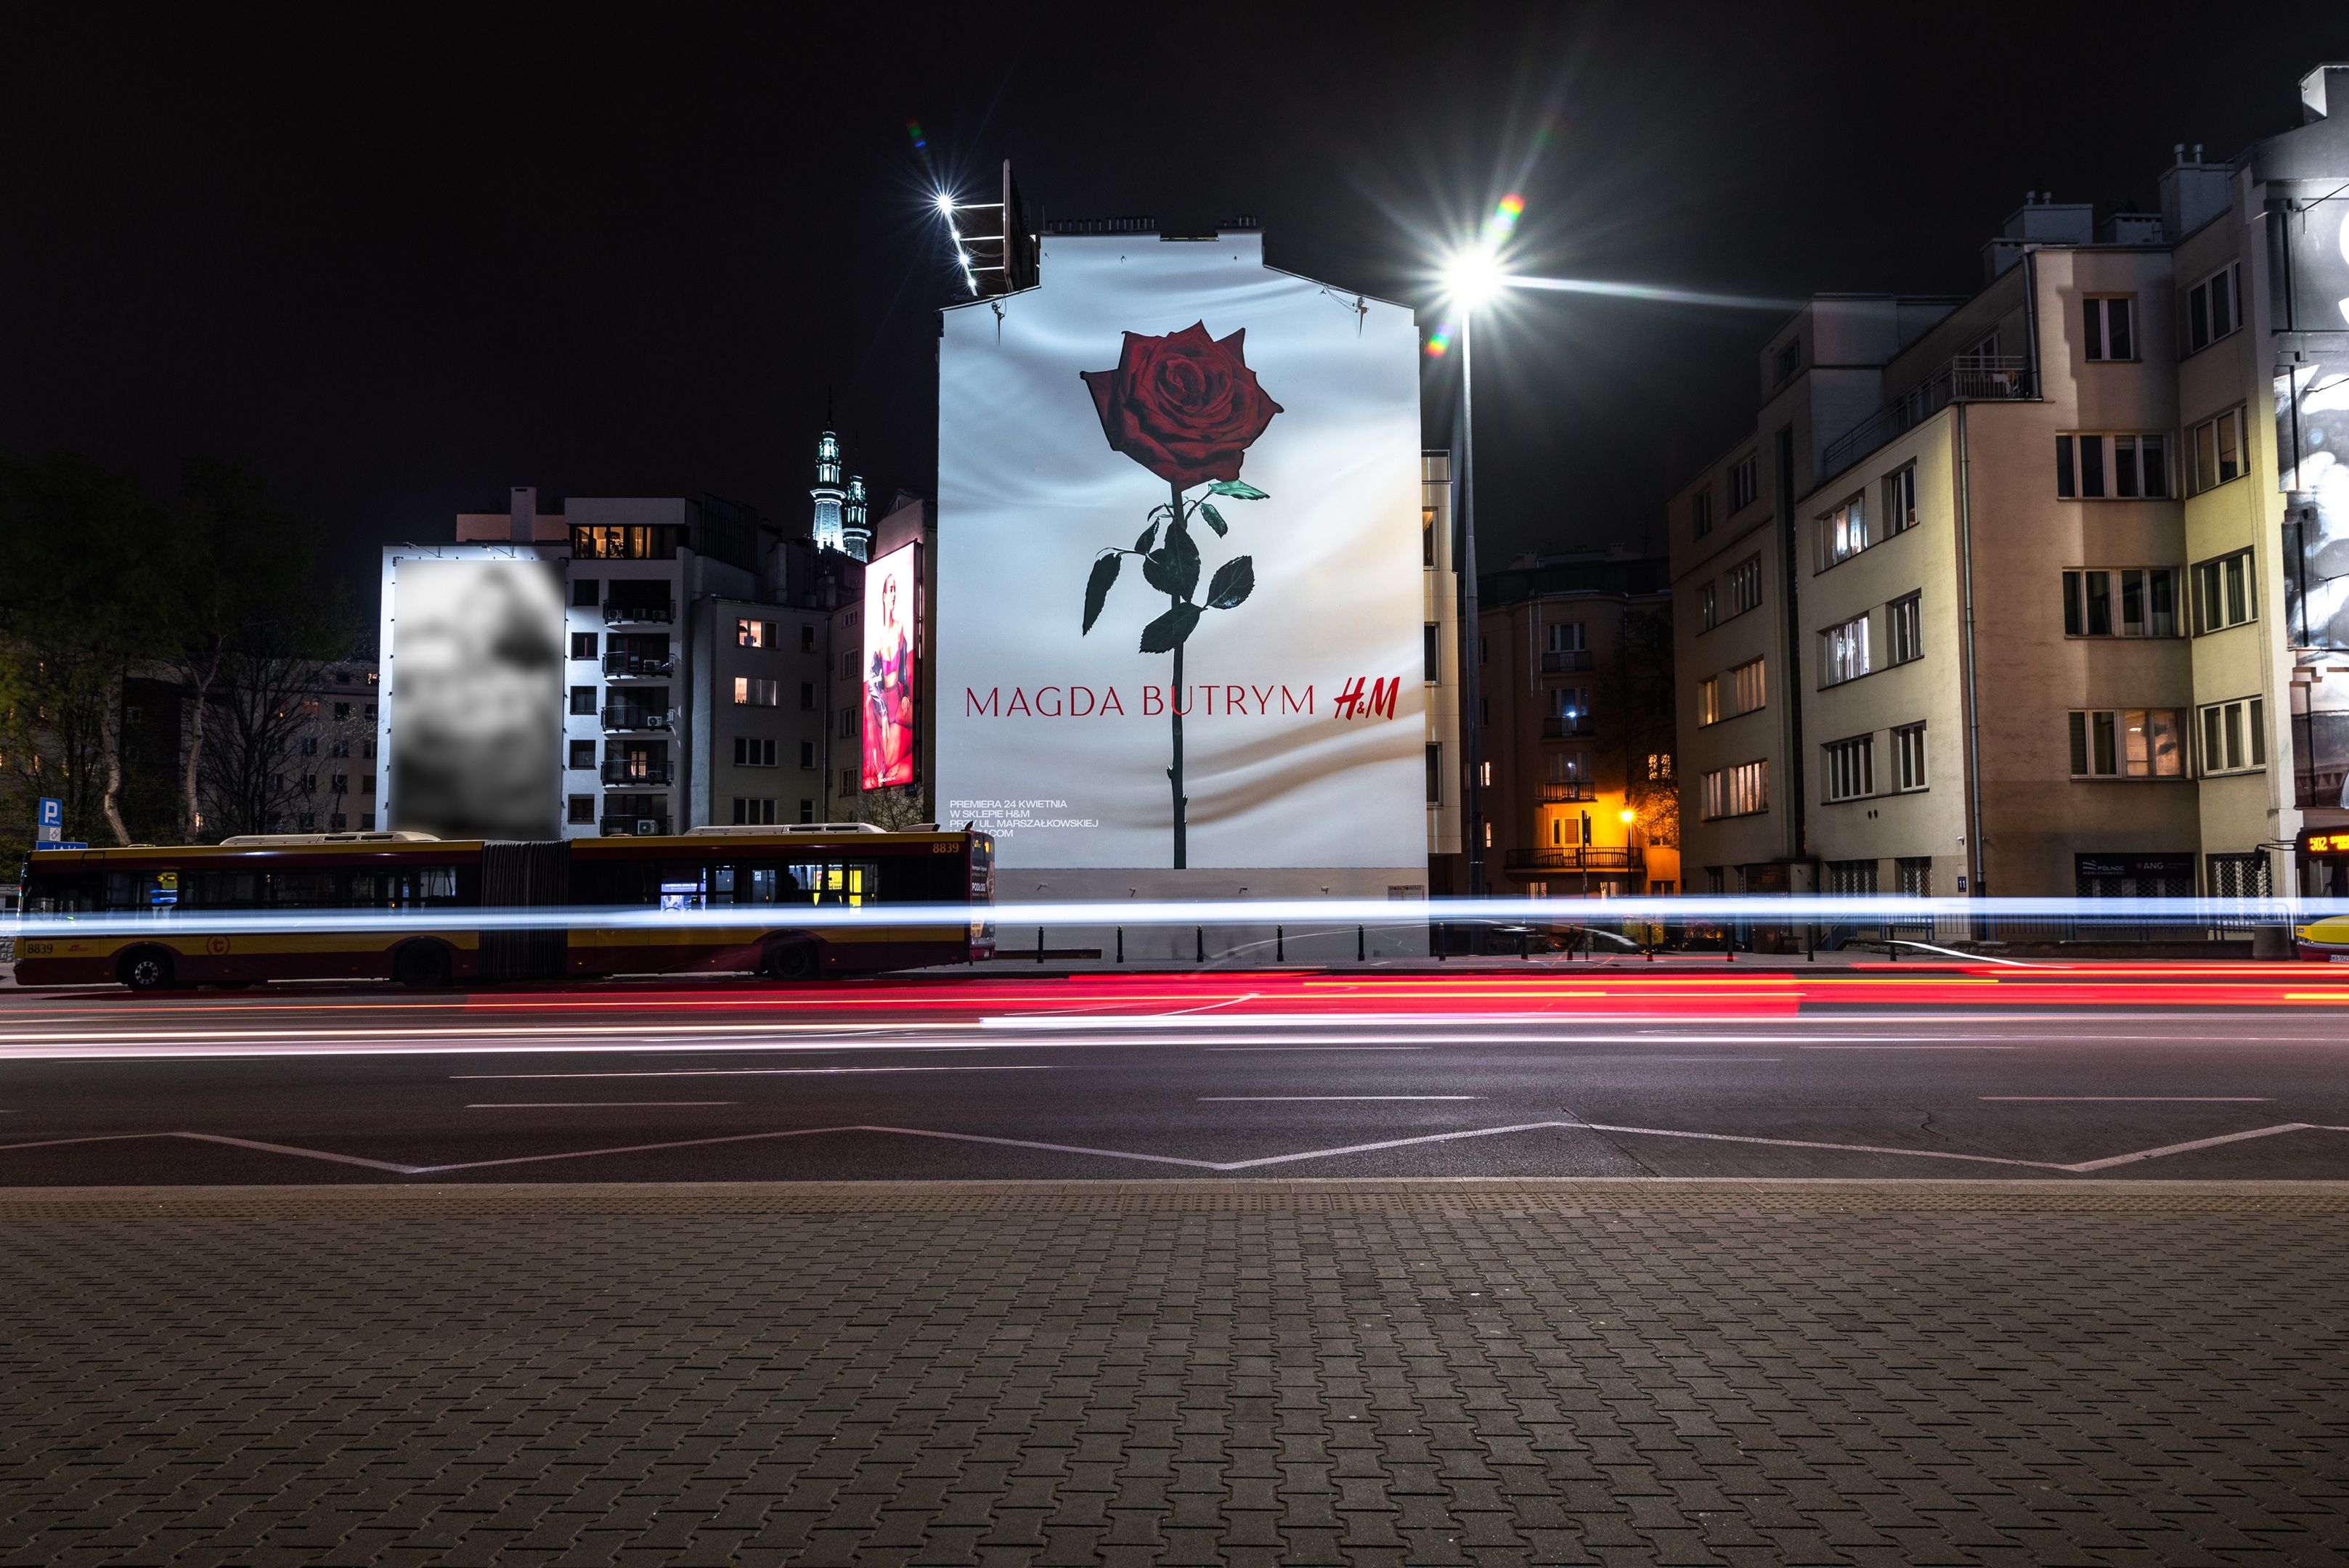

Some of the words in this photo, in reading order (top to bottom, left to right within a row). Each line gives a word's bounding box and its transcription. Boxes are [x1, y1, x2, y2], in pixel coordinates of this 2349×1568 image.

[966, 686, 1124, 717] MAGDA
[1143, 685, 1314, 716] BUTRYM
[1334, 676, 1400, 720] H&M
[950, 800, 1002, 809] PREMIERA
[44, 801, 58, 823] P
[950, 809, 961, 818] W
[962, 809, 1003, 818] SKLEPIE
[1006, 809, 1030, 818] H&M
[980, 819, 995, 828] UL.
[997, 819, 1099, 828] MARSZAŁKOWSKIEJ
[932, 842, 960, 854] 8839
[1958, 880, 1966, 889] 11
[28, 943, 53, 954] 8839
